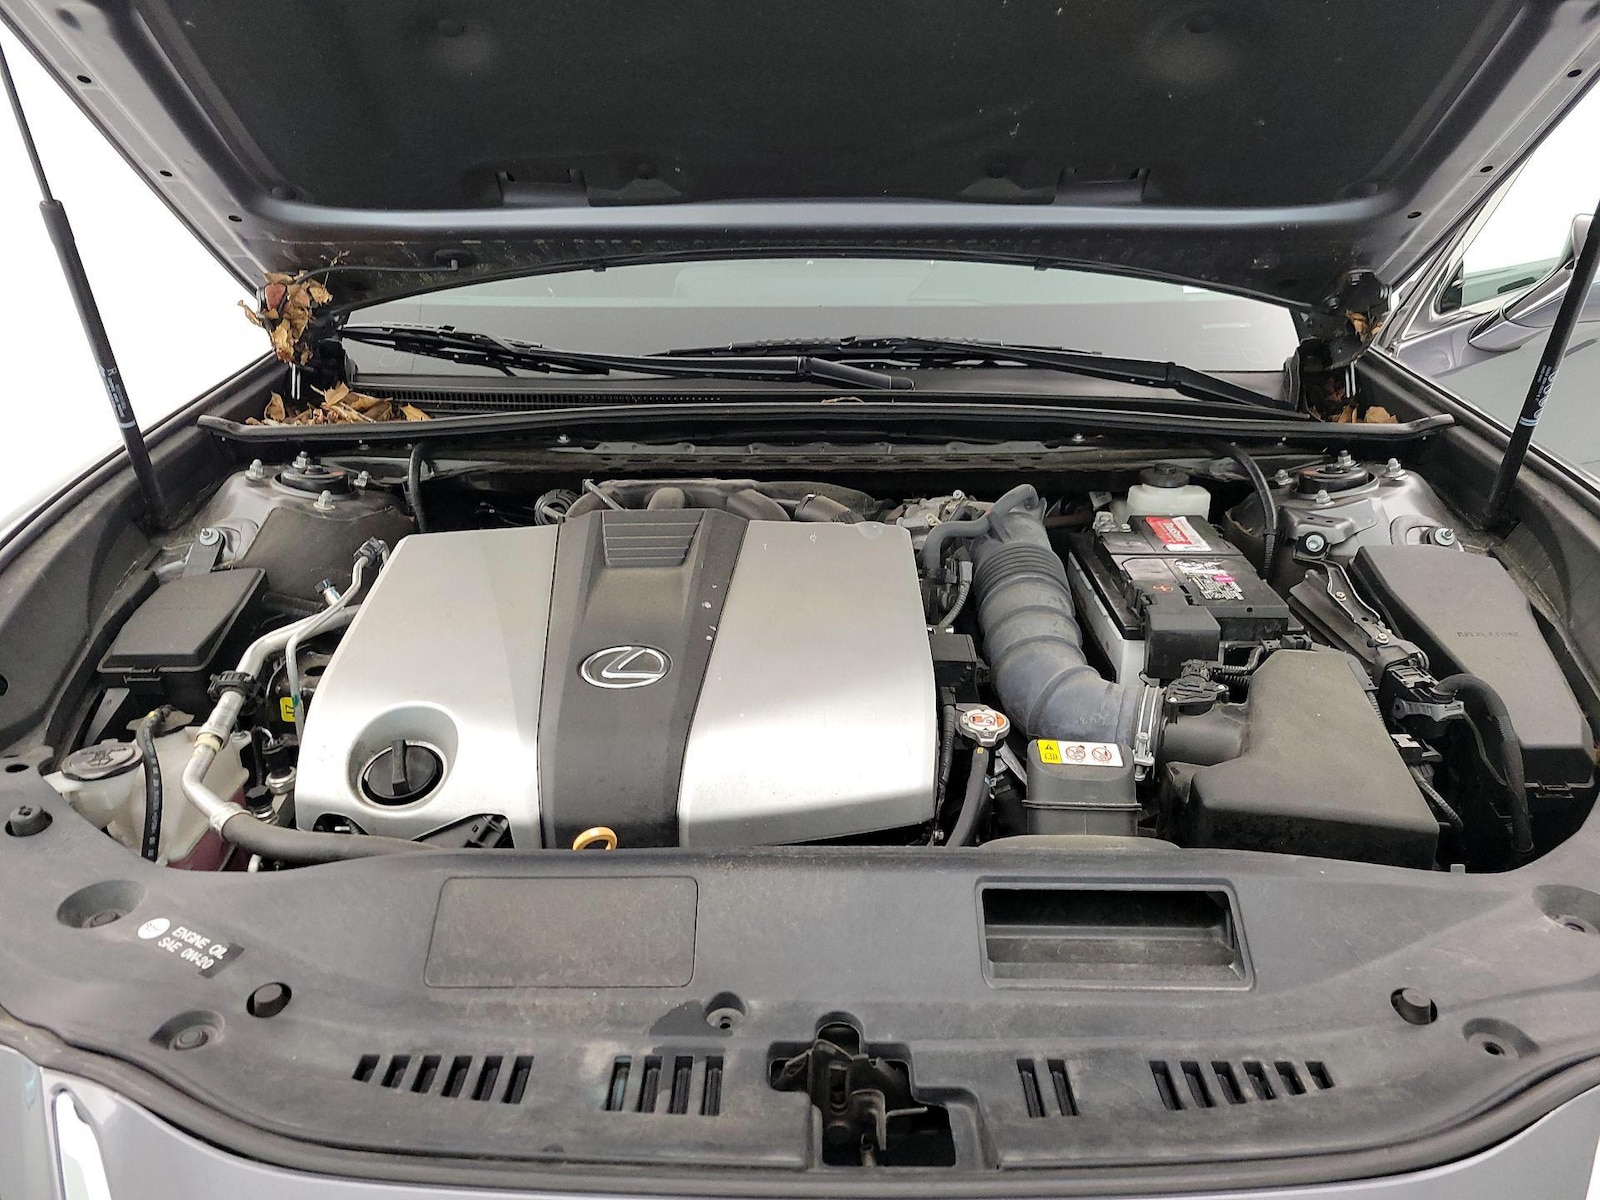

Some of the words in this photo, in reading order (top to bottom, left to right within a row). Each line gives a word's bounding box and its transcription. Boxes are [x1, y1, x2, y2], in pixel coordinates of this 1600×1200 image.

[157, 937, 183, 953] SAE
[180, 947, 215, 970] 0W-20
[172, 926, 211, 949] ENGINE
[208, 944, 228, 960] OIL
